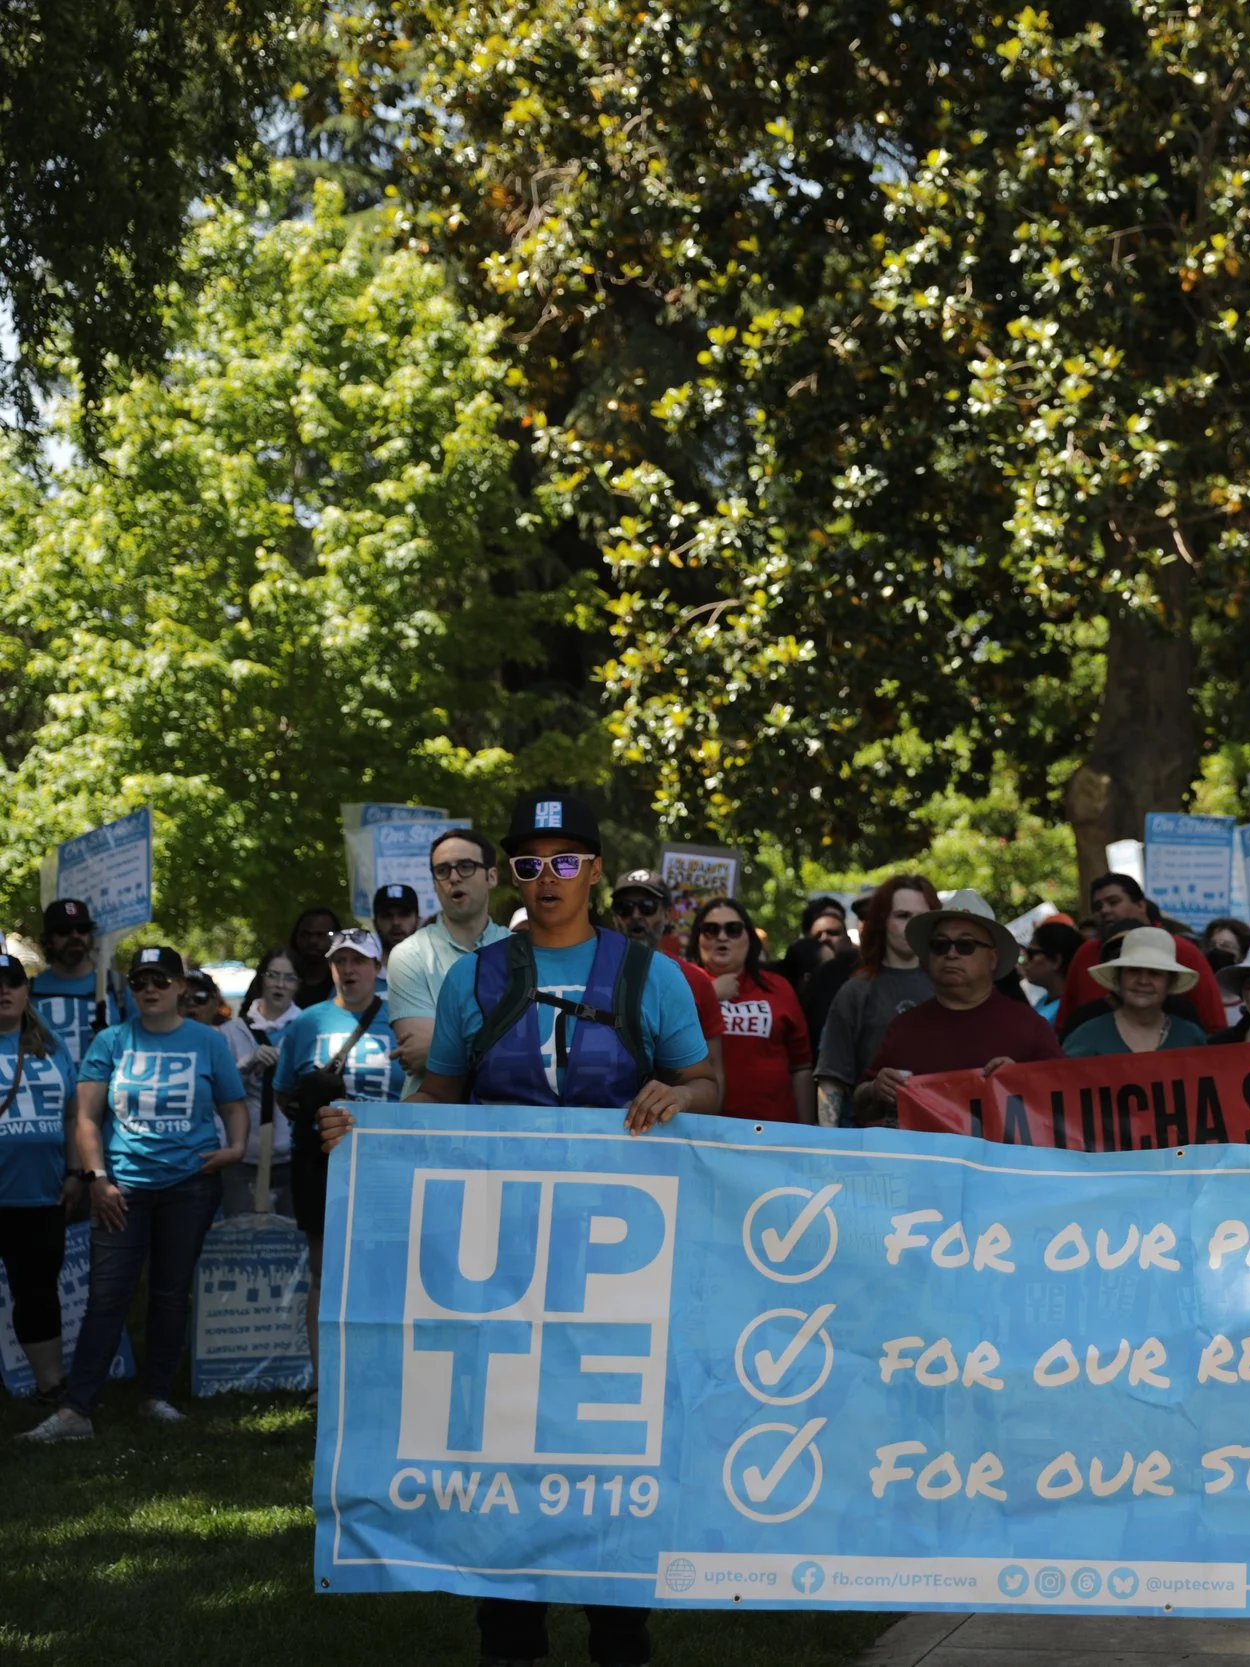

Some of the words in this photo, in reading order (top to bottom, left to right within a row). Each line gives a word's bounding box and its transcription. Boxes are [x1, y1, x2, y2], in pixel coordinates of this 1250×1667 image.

[535, 815, 562, 828] TE
[536, 801, 562, 815] UP
[720, 1003, 768, 1014] NITE
[122, 1053, 192, 1083] UP
[117, 1082, 189, 1117] TE
[155, 1119, 191, 1133] 9119
[418, 1178, 667, 1314] UP
[883, 1208, 1015, 1273] FOR
[1043, 1222, 1181, 1273] OUR
[879, 1336, 1004, 1390] FOR
[1032, 1337, 1171, 1389] OUR
[413, 1318, 652, 1456] TE
[869, 1440, 1007, 1502] FOR
[1036, 1450, 1174, 1500] OUR
[388, 1467, 520, 1515] CWA
[539, 1473, 661, 1518] 9119
[704, 1569, 777, 1586] upte.org
[832, 1570, 978, 1588] fb.com/UPTEcwa
[1146, 1576, 1236, 1593] @uptecwa
